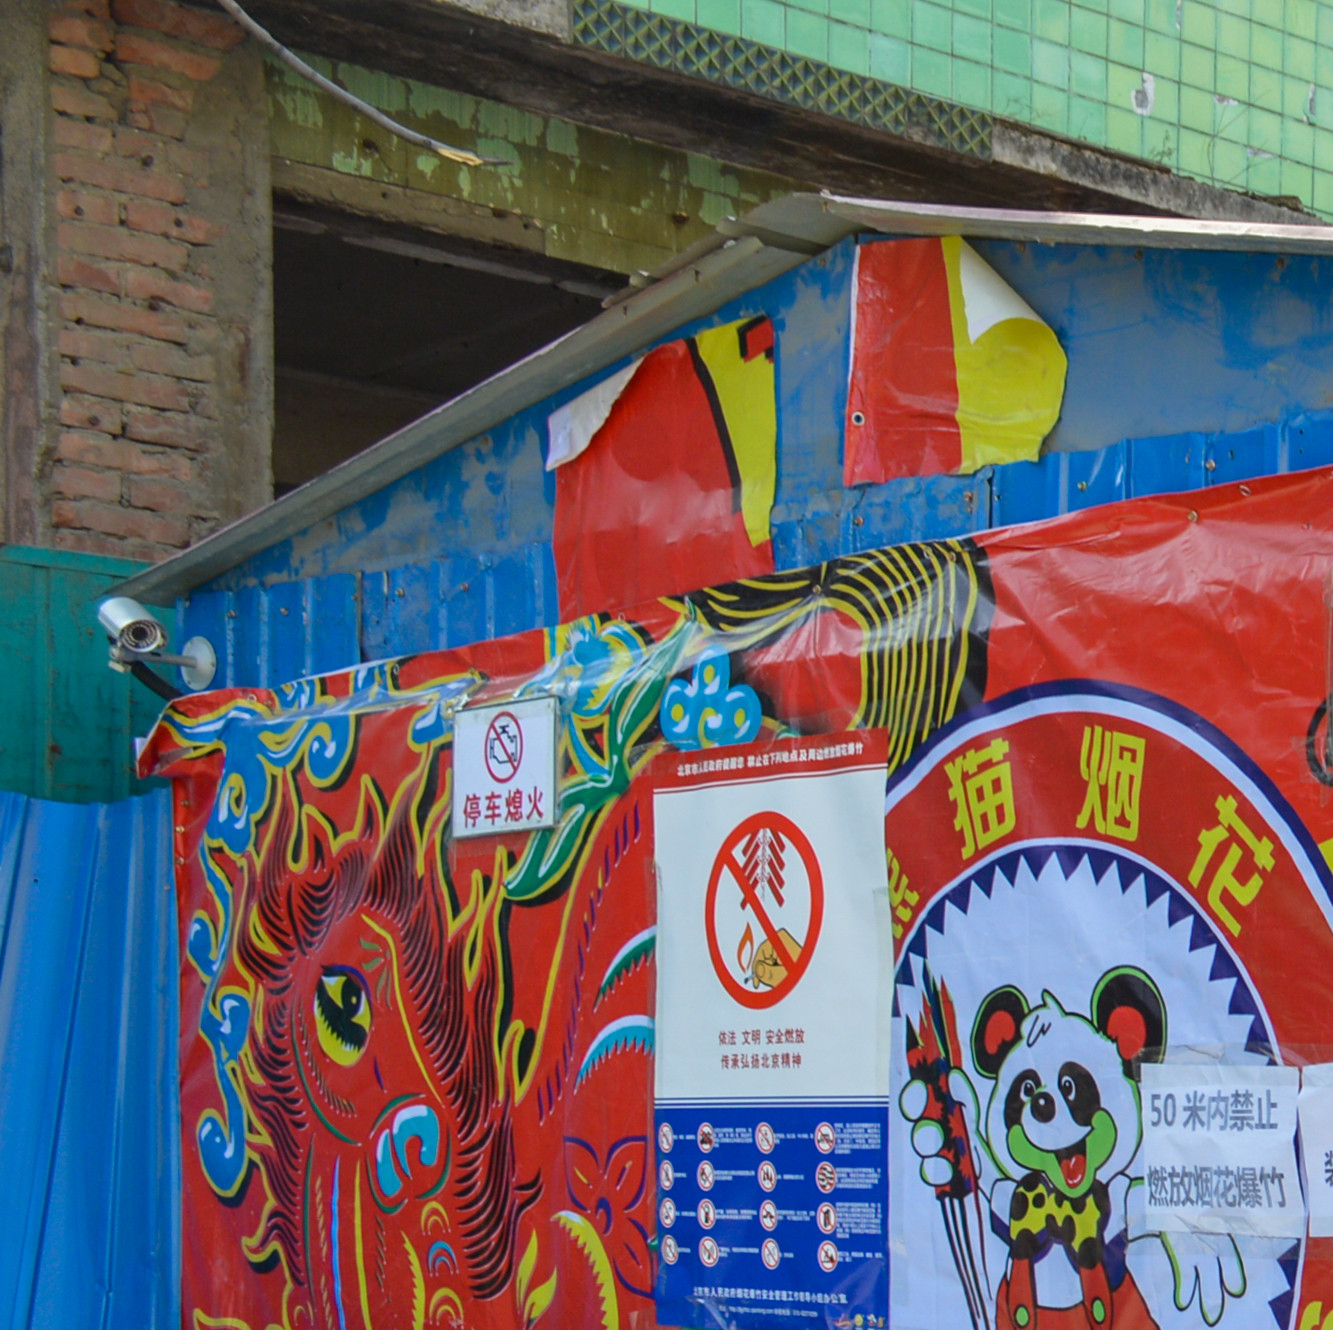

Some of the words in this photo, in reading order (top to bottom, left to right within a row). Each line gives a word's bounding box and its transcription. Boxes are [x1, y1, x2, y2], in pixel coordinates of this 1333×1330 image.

[462, 789, 545, 829] 停车熄火
[718, 1029, 737, 1045] 依法
[742, 1028, 761, 1045] 文明
[766, 1027, 805, 1044] 安全燃放
[721, 1052, 802, 1069] 传承弘扬北京精神
[1151, 1092, 1177, 1128] 50
[1182, 1088, 1278, 1130] 米内禁止
[1147, 1164, 1287, 1210] 燃放烟花爆竹
